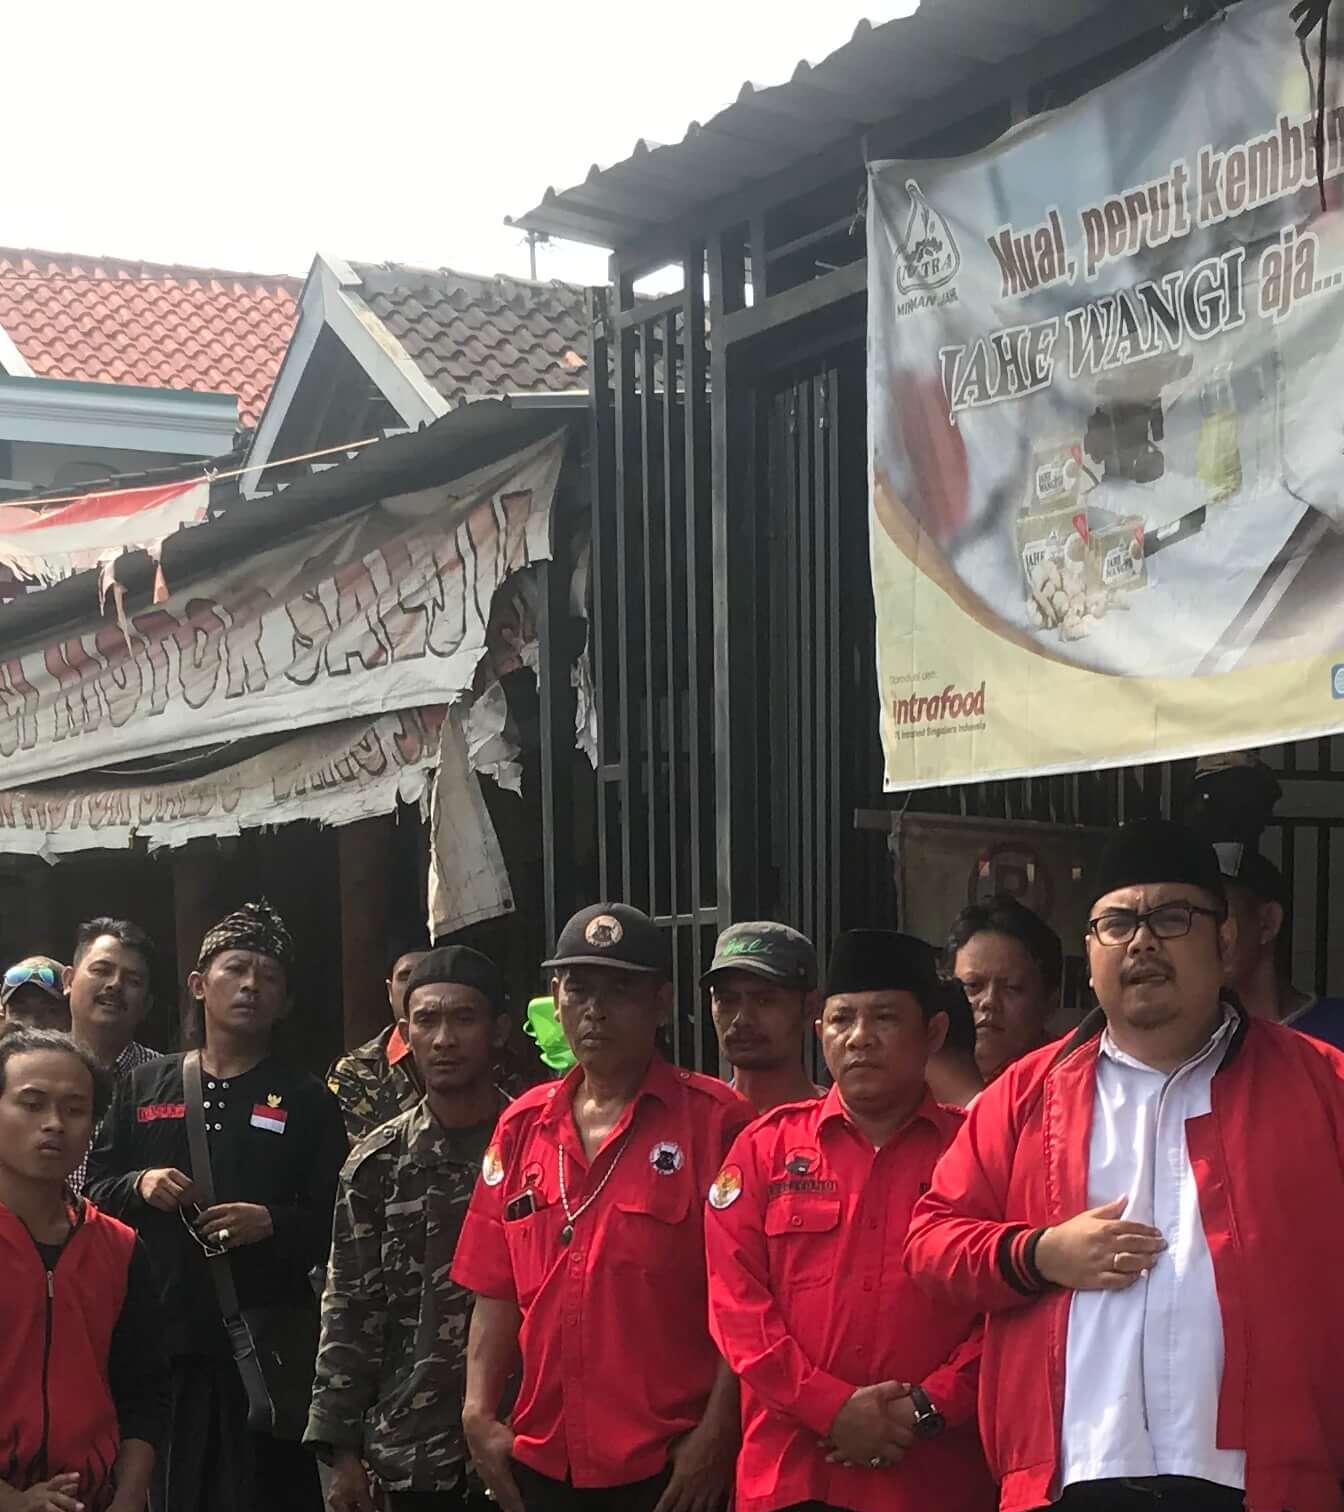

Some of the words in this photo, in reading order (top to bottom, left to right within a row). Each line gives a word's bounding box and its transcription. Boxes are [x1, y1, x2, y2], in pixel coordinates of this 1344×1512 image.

[986, 209, 1078, 300] Mual,
[1079, 164, 1191, 278] perut
[1065, 246, 1248, 382] WANGI
[43, 587, 270, 743] MOTOR
